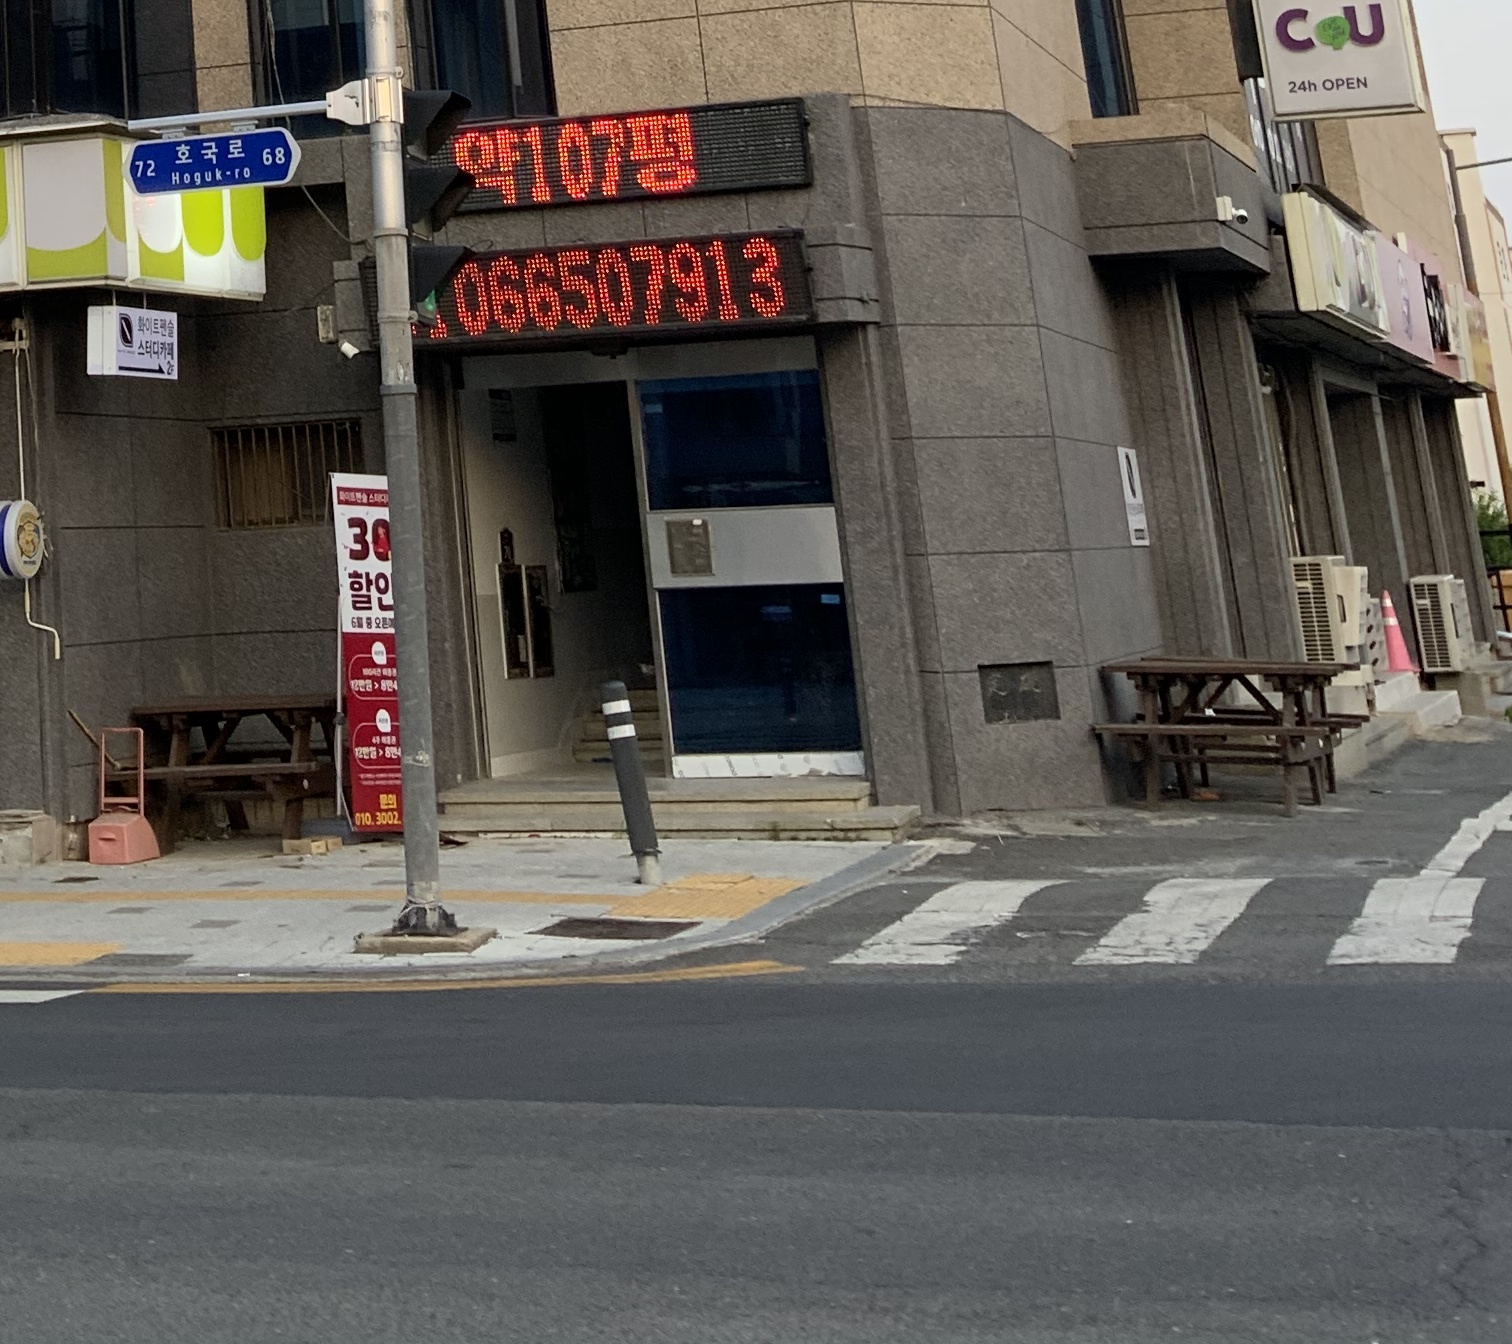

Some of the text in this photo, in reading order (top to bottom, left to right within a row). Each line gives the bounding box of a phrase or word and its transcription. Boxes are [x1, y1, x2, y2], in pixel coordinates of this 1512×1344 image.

[1275, 3, 1385, 52] CU
[1287, 76, 1368, 94] 24h OPEN
[175, 139, 246, 164] 호국로
[135, 146, 286, 186] 72 Hoguk-ro 68
[138, 316, 175, 338] 화이트펜슬
[138, 340, 174, 360] 스터디카페
[380, 794, 397, 809] 문의
